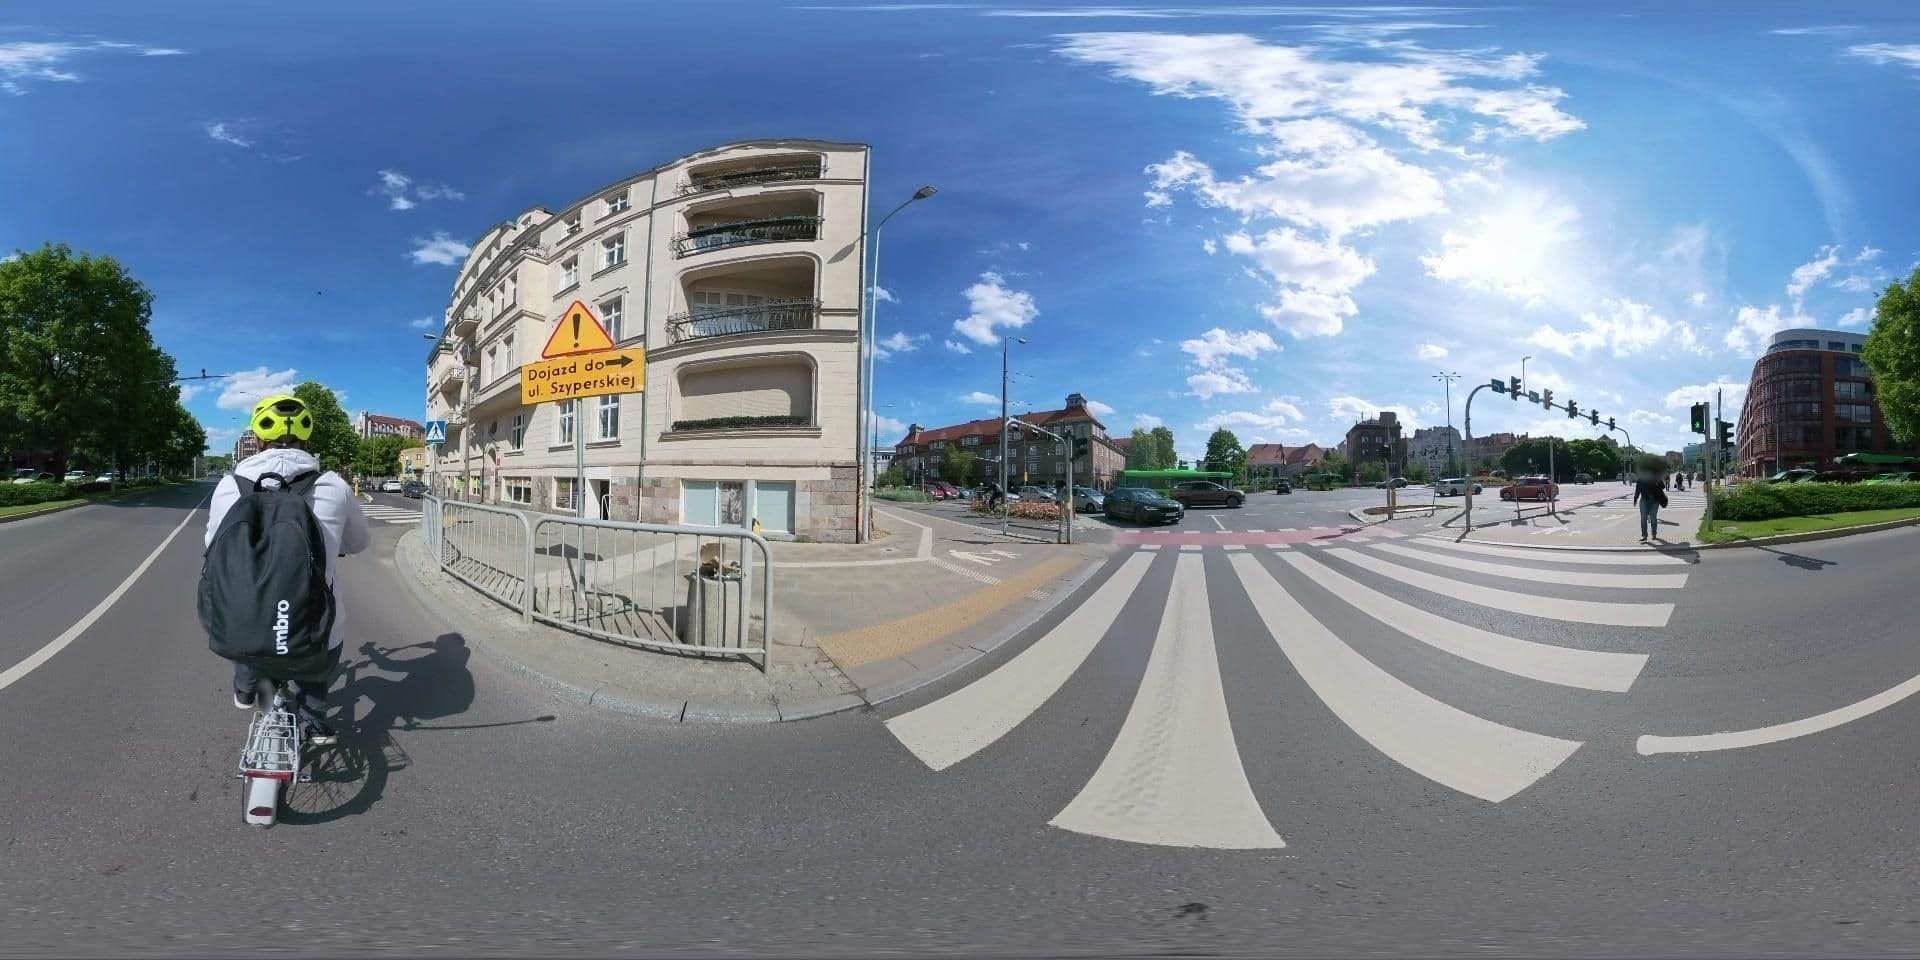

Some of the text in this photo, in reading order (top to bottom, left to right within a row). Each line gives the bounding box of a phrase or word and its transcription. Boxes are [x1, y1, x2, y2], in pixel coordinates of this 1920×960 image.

[528, 359, 605, 381] Dojazd do
[528, 374, 635, 398] ul. Szyperskiej
[272, 599, 290, 655] umbro
